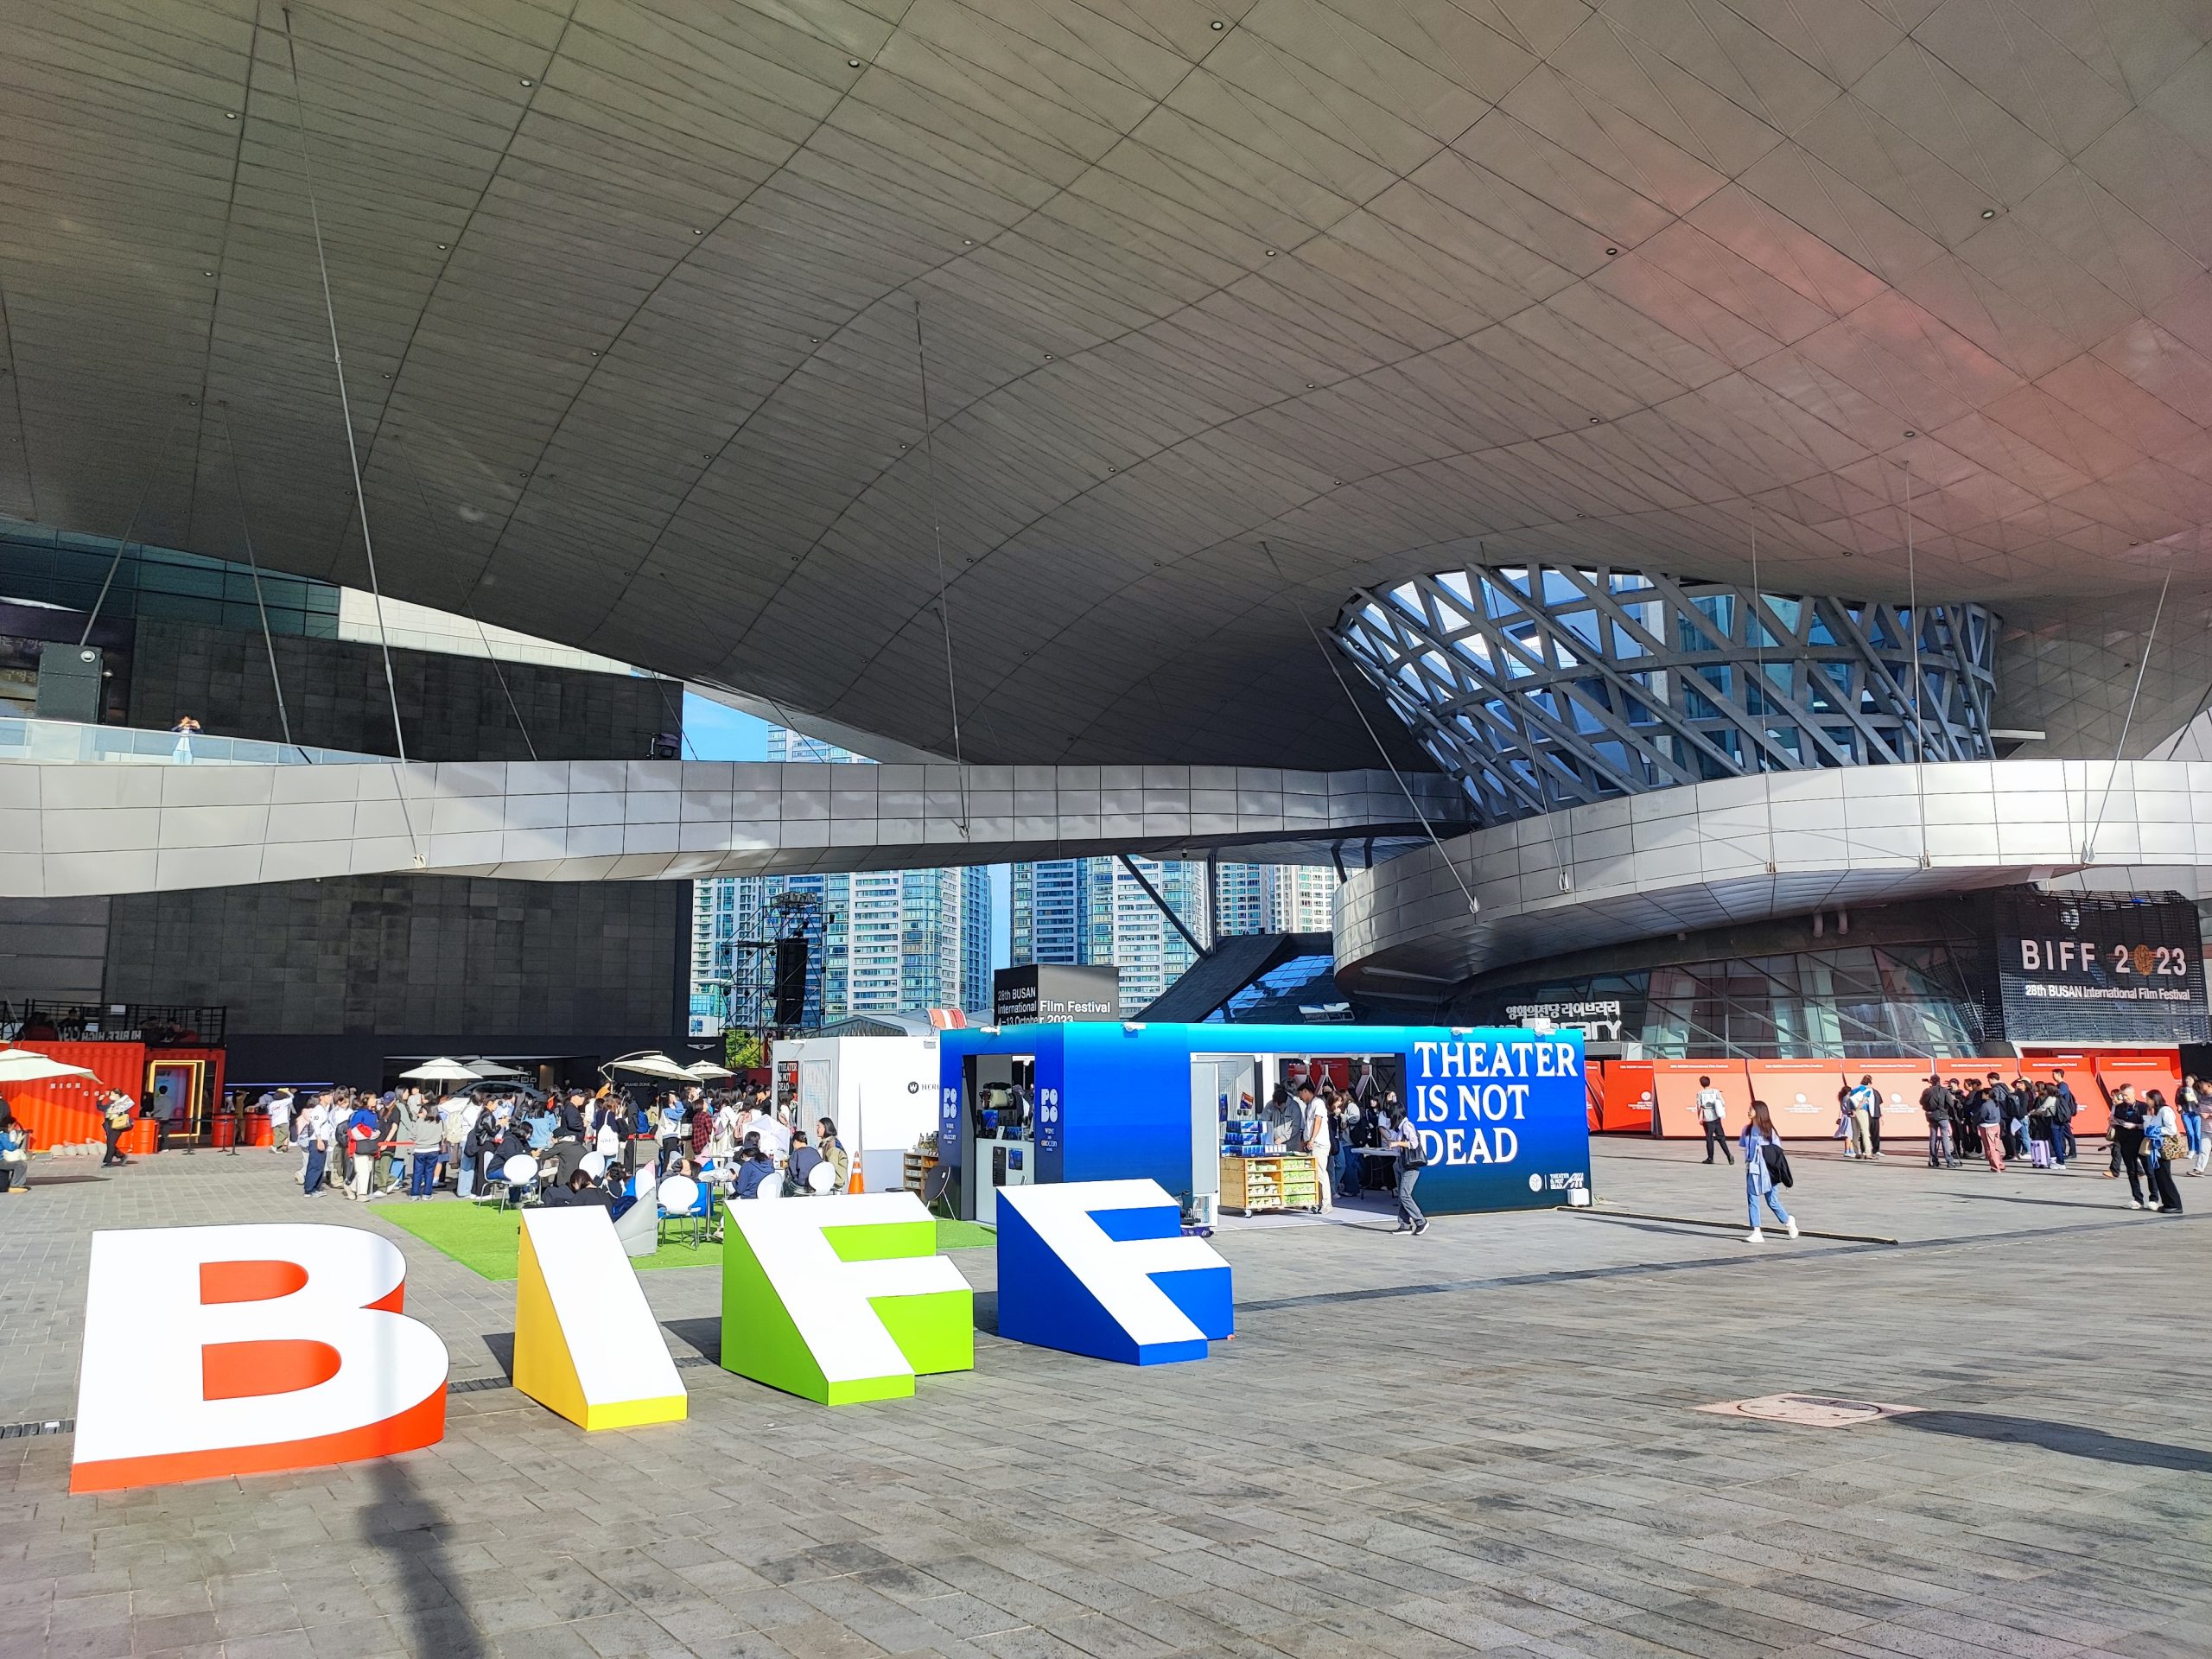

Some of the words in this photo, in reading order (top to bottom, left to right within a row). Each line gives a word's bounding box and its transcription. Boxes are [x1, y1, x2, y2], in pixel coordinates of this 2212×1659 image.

[2020, 939, 2095, 972] BIFF
[997, 988, 1011, 1001] 28th
[1012, 986, 1036, 1000] BUSAN
[2025, 984, 2047, 997] 28th
[2049, 984, 2082, 998] BUSAN
[2083, 985, 2137, 1000] International
[2139, 987, 2158, 1000] Film
[2159, 988, 2190, 1001] Festival
[997, 1001, 1037, 1015] International
[1039, 1001, 1065, 1013] Film
[1067, 1001, 1111, 1014] Festival
[1505, 1003, 1560, 1020] 영화의전당
[1561, 1001, 1620, 1018] 라이브러리
[779, 1062, 798, 1072] THEATER
[1414, 1041, 1579, 1077] THEATER
[1415, 1084, 1449, 1122] IS
[1457, 1084, 1529, 1122] NOT
[1417, 1127, 1518, 1166] DEAD
